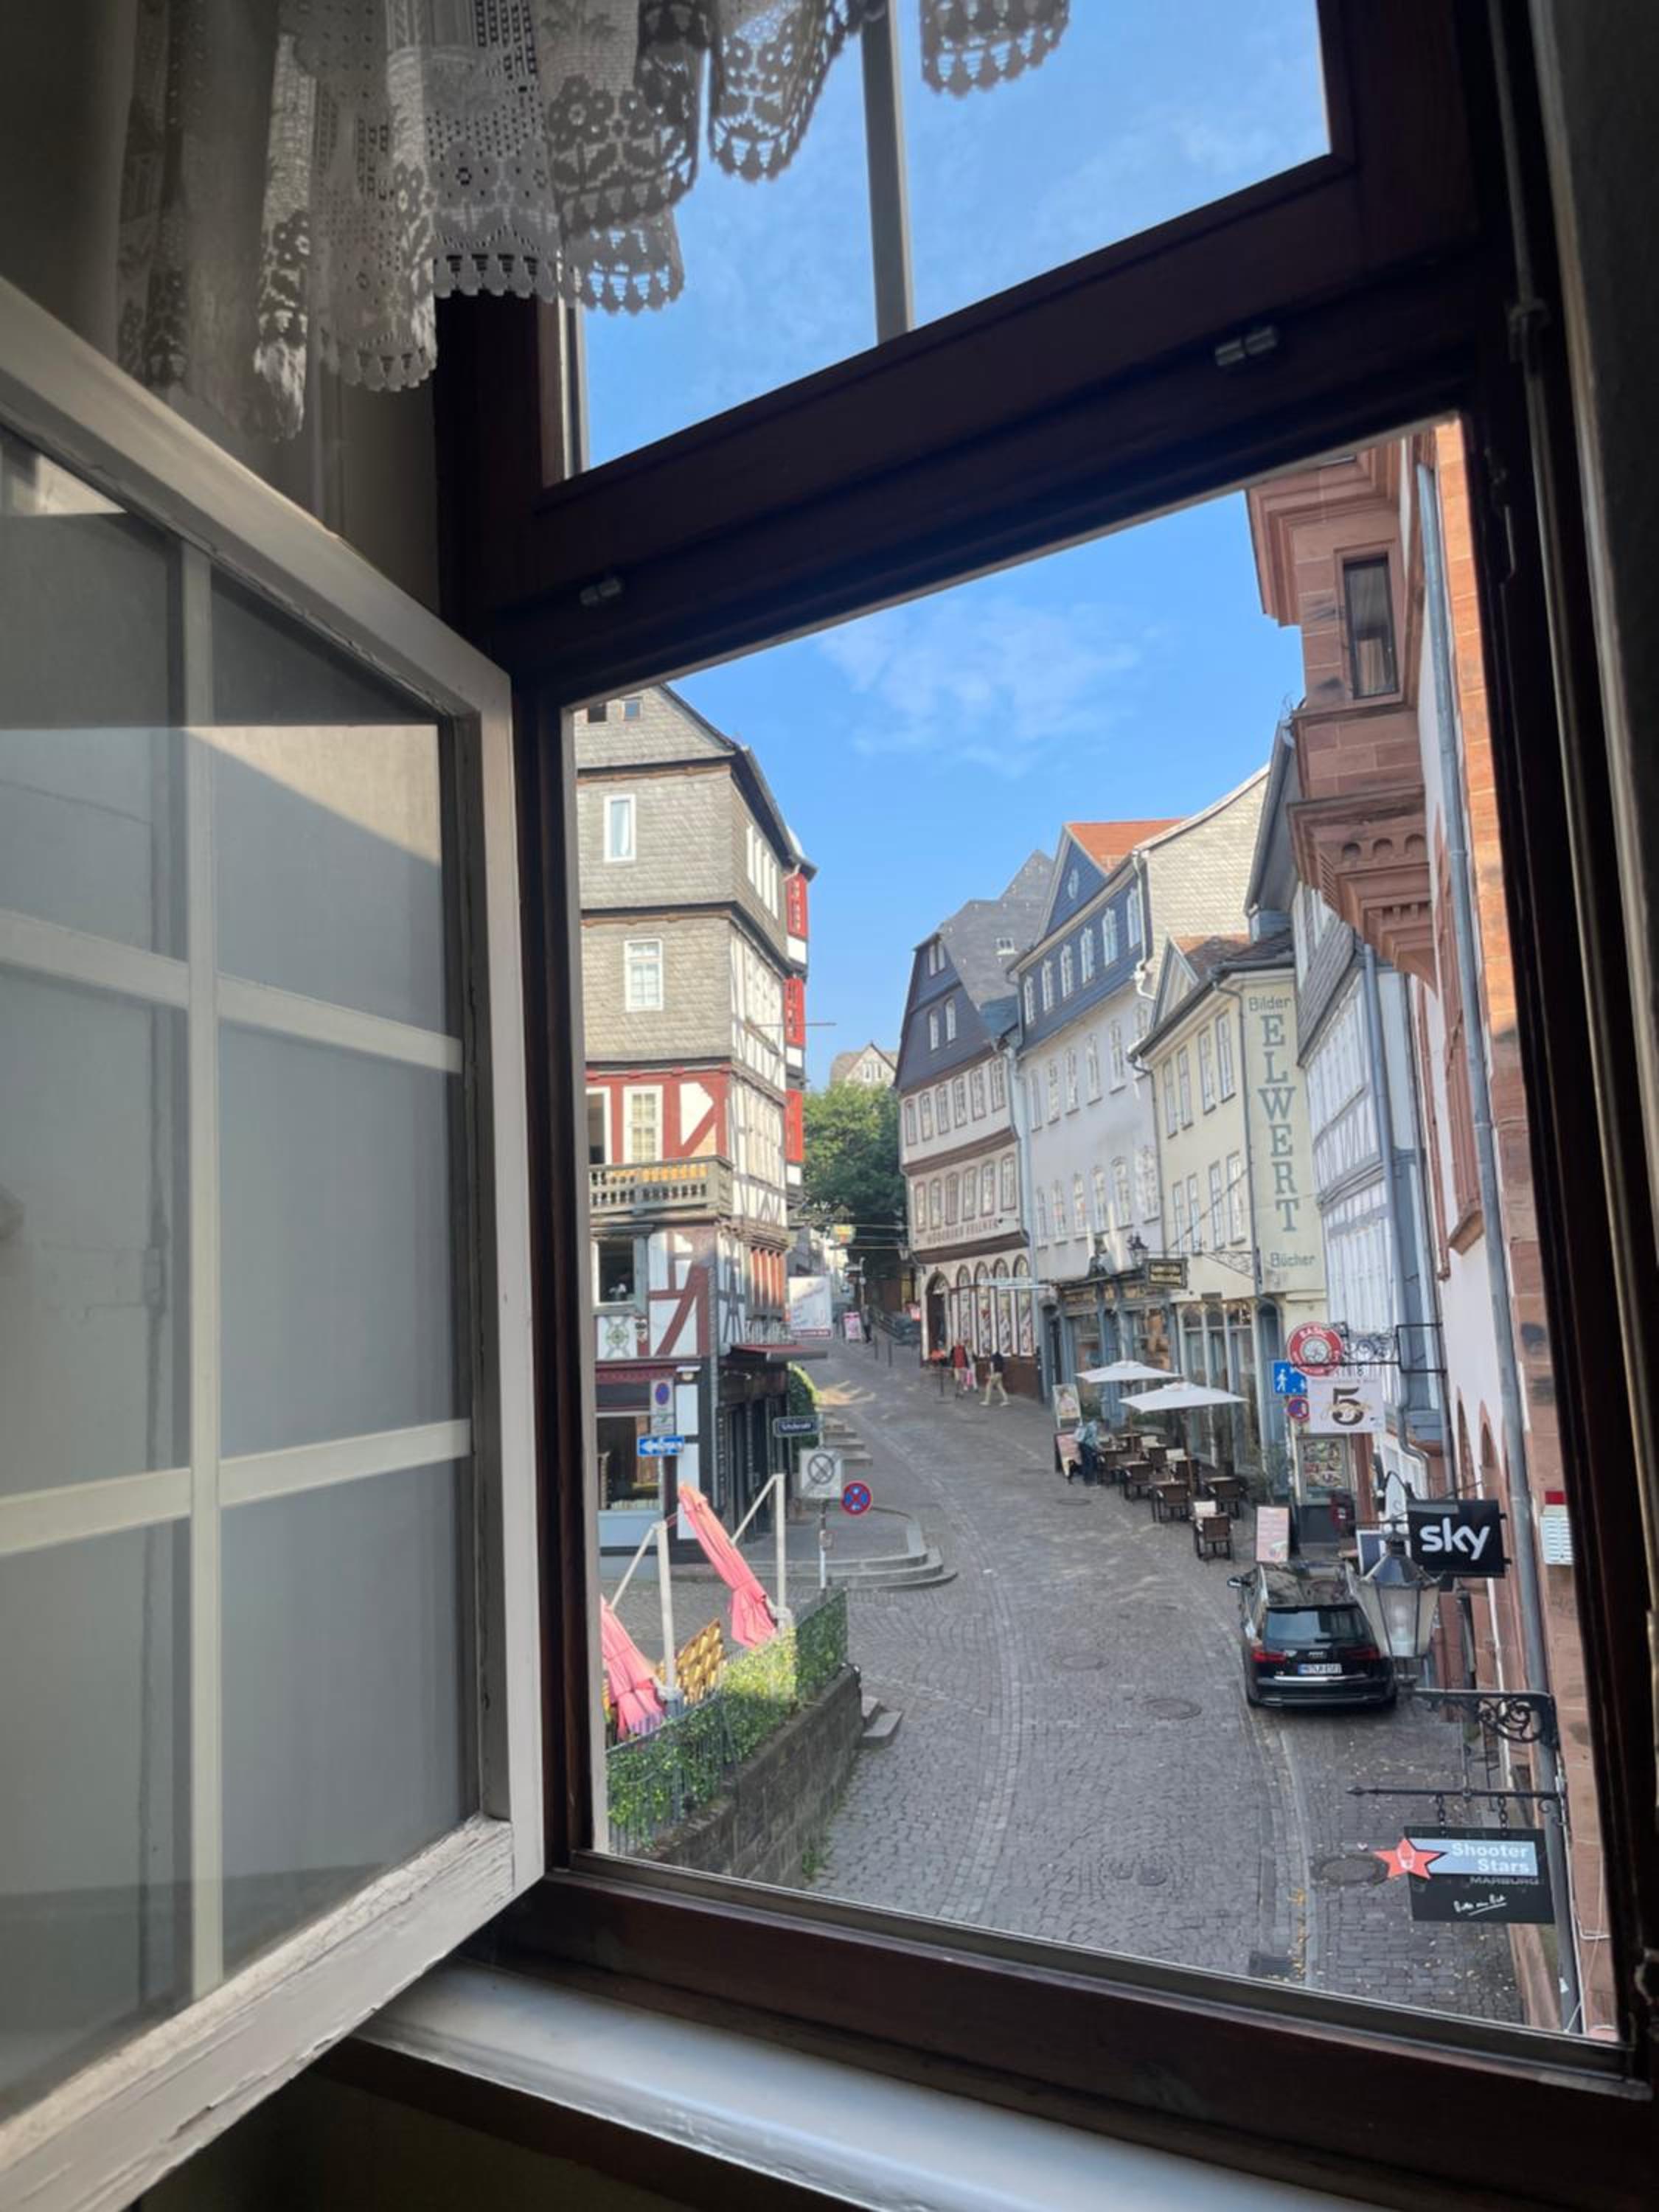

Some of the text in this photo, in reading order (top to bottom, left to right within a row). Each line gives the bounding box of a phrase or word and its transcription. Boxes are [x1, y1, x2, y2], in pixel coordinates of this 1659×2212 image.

[1249, 996, 1292, 1012] Bilder
[1258, 1015, 1299, 1232] ELWERT
[1270, 1252, 1316, 1267] Bücher
[1332, 1386, 1364, 1426] 5
[1419, 1517, 1490, 1561] sky
[1452, 1843, 1528, 1858] Shooter
[1478, 1858, 1531, 1874] Stars
[1470, 1875, 1540, 1885] MARBURG
